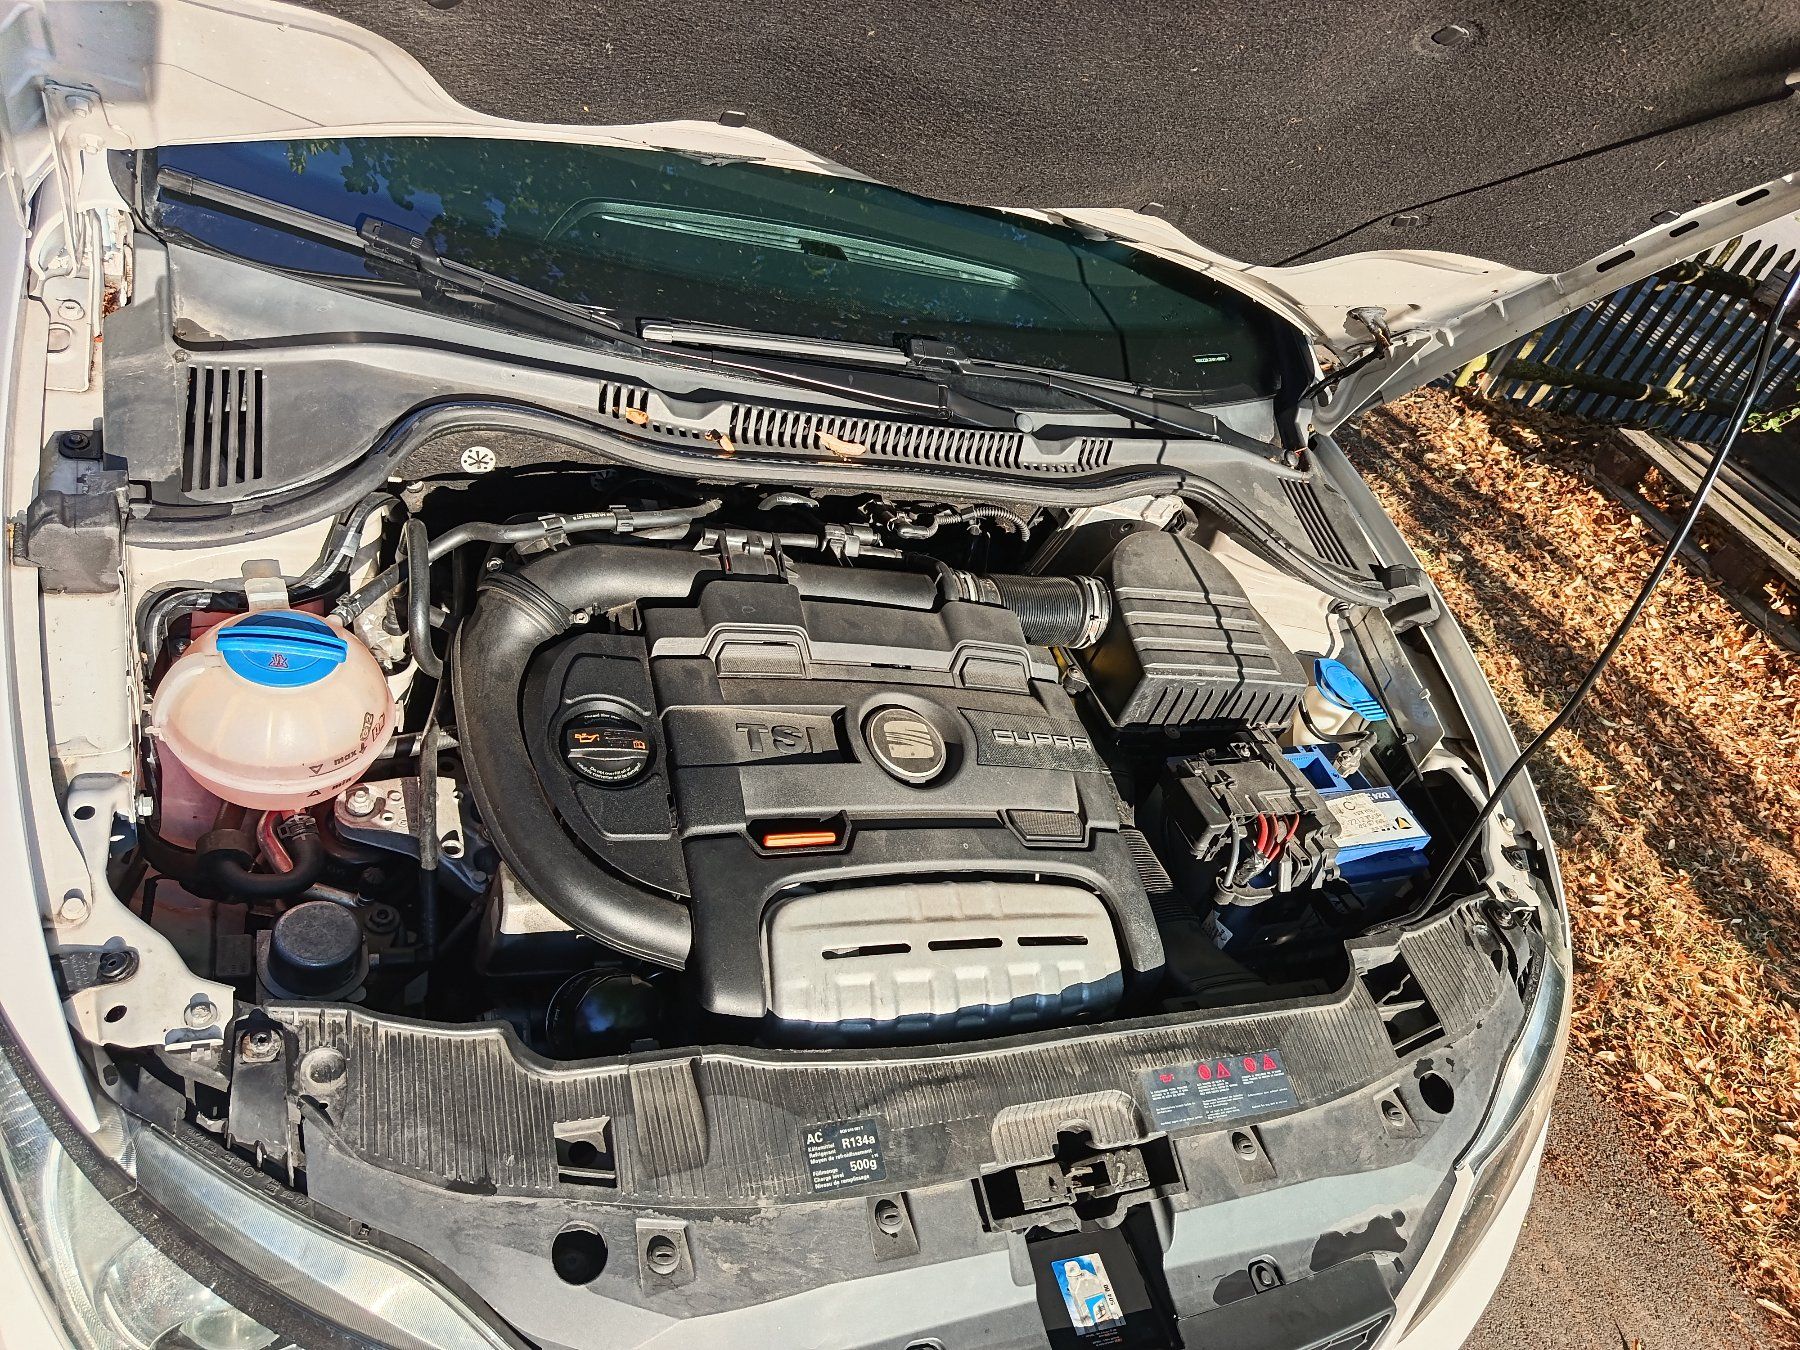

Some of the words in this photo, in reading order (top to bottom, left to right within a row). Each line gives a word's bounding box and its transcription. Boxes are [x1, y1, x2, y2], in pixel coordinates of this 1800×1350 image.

[735, 721, 826, 755] TSI
[991, 728, 1091, 750] CUPRA
[333, 749, 357, 765] max
[331, 777, 352, 790] min
[807, 1131, 823, 1145] AC
[841, 1134, 876, 1150] R134a
[807, 1142, 835, 1152] Kältemittel
[809, 1149, 837, 1158] Refrigerant
[810, 1157, 828, 1165] Moyen
[849, 1158, 878, 1172] 500g
[812, 1168, 839, 1177] Füllmenge
[832, 1171, 845, 1179] level
[814, 1181, 833, 1190] Niveau
[840, 1174, 870, 1184] remplissage
